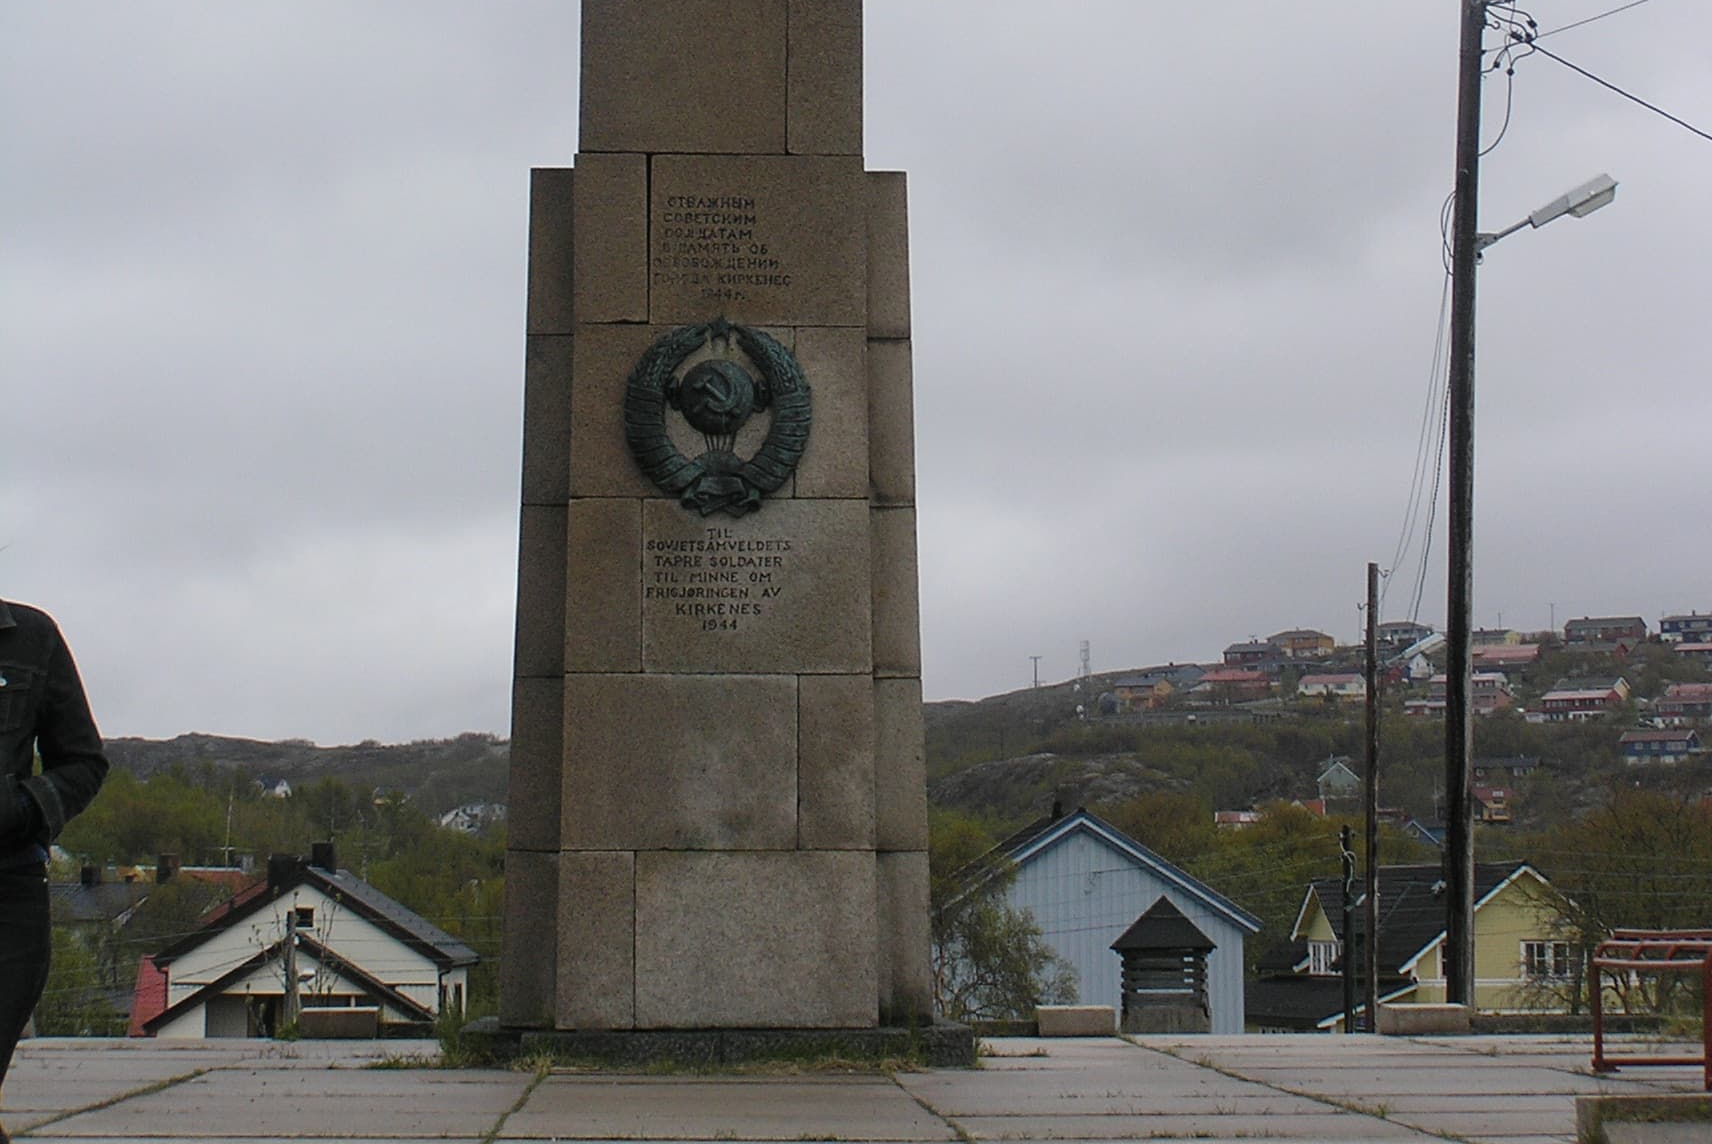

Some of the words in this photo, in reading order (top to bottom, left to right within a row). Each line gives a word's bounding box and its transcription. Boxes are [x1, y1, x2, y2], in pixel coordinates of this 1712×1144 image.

[667, 196, 755, 209] ОТВАЖНЫМ
[663, 212, 756, 225] СОВЕТСКИМ
[664, 227, 753, 240] СОЛДАТАМ
[679, 242, 740, 254] ПАМЯТЬ
[749, 243, 768, 255] ОБ
[718, 273, 792, 286] КИРКЕНЕС
[706, 527, 732, 540] TIL
[646, 540, 792, 553] SOVJETSAMVELDETS
[653, 555, 703, 567] TAPRE
[709, 556, 783, 568] SOLDATER
[654, 571, 679, 583] TIL
[690, 571, 739, 583] MINNE
[749, 571, 771, 583] OM
[645, 586, 749, 599] FRIGJØRINGEN
[761, 586, 782, 599] AV
[675, 602, 762, 616] KIRKENES
[702, 618, 738, 631] 1944
